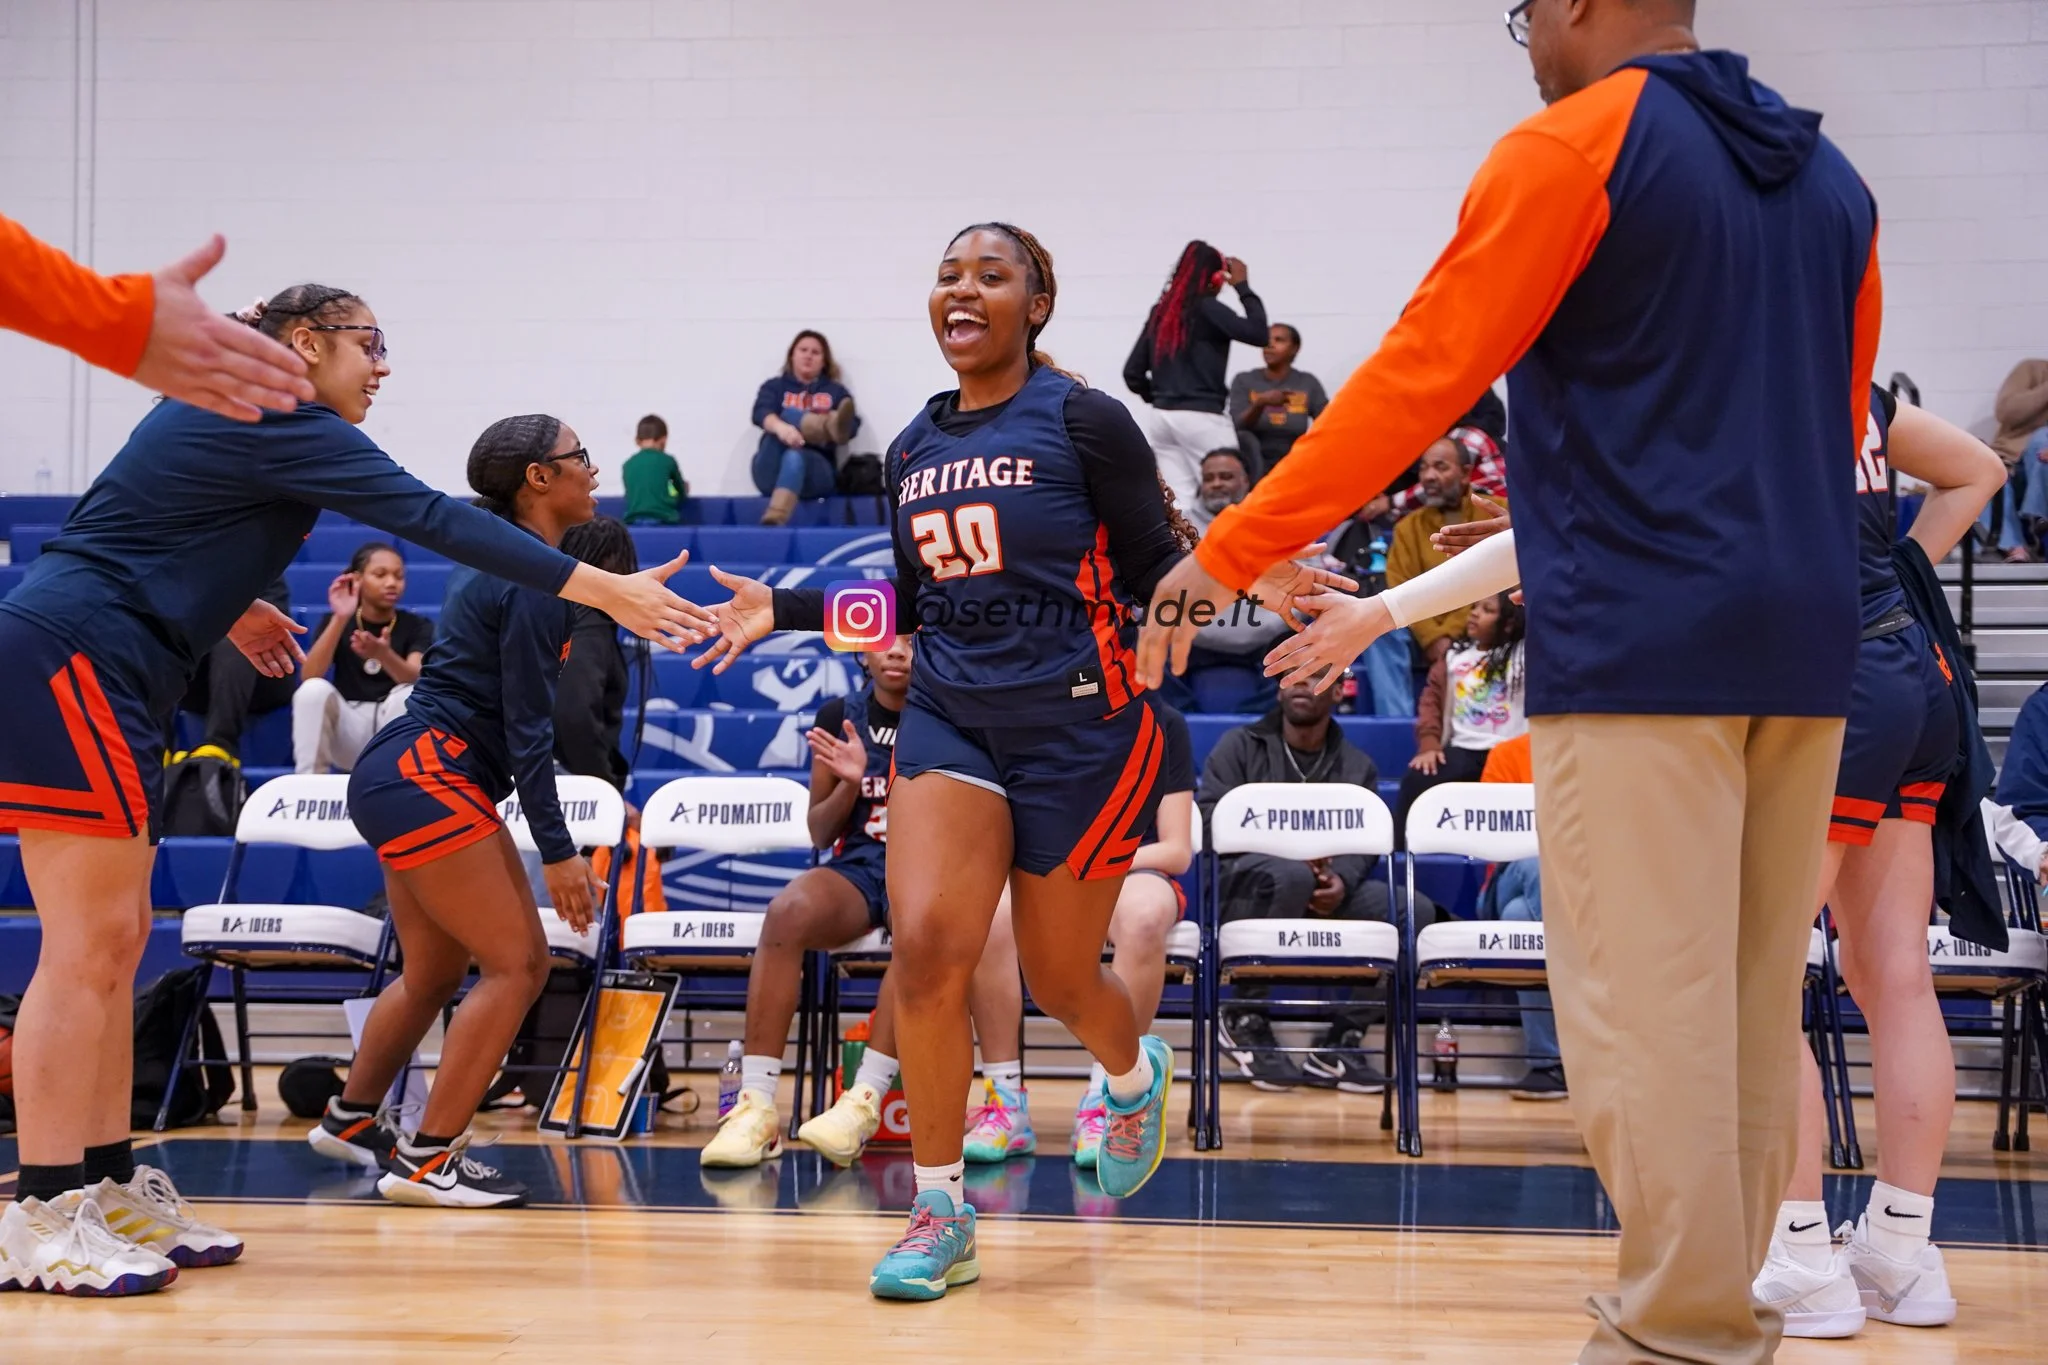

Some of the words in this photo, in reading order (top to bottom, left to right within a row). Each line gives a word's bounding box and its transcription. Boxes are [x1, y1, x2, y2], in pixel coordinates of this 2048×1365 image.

[1856, 411, 1888, 494] 2
[910, 502, 1004, 583] 20
[1078, 672, 1088, 682] L
[267, 798, 351, 821] APPOMA
[670, 801, 792, 824] APPOMATTOX
[1240, 807, 1364, 831] APPOMATTOX
[1436, 807, 1535, 832] APPOMAT
[222, 917, 283, 933] RAIDERS
[673, 922, 734, 938] RAIDERS
[1279, 930, 1341, 947] RAIDERS
[1479, 933, 1544, 950] RAIDERS
[1927, 939, 1991, 957] AIDERS
